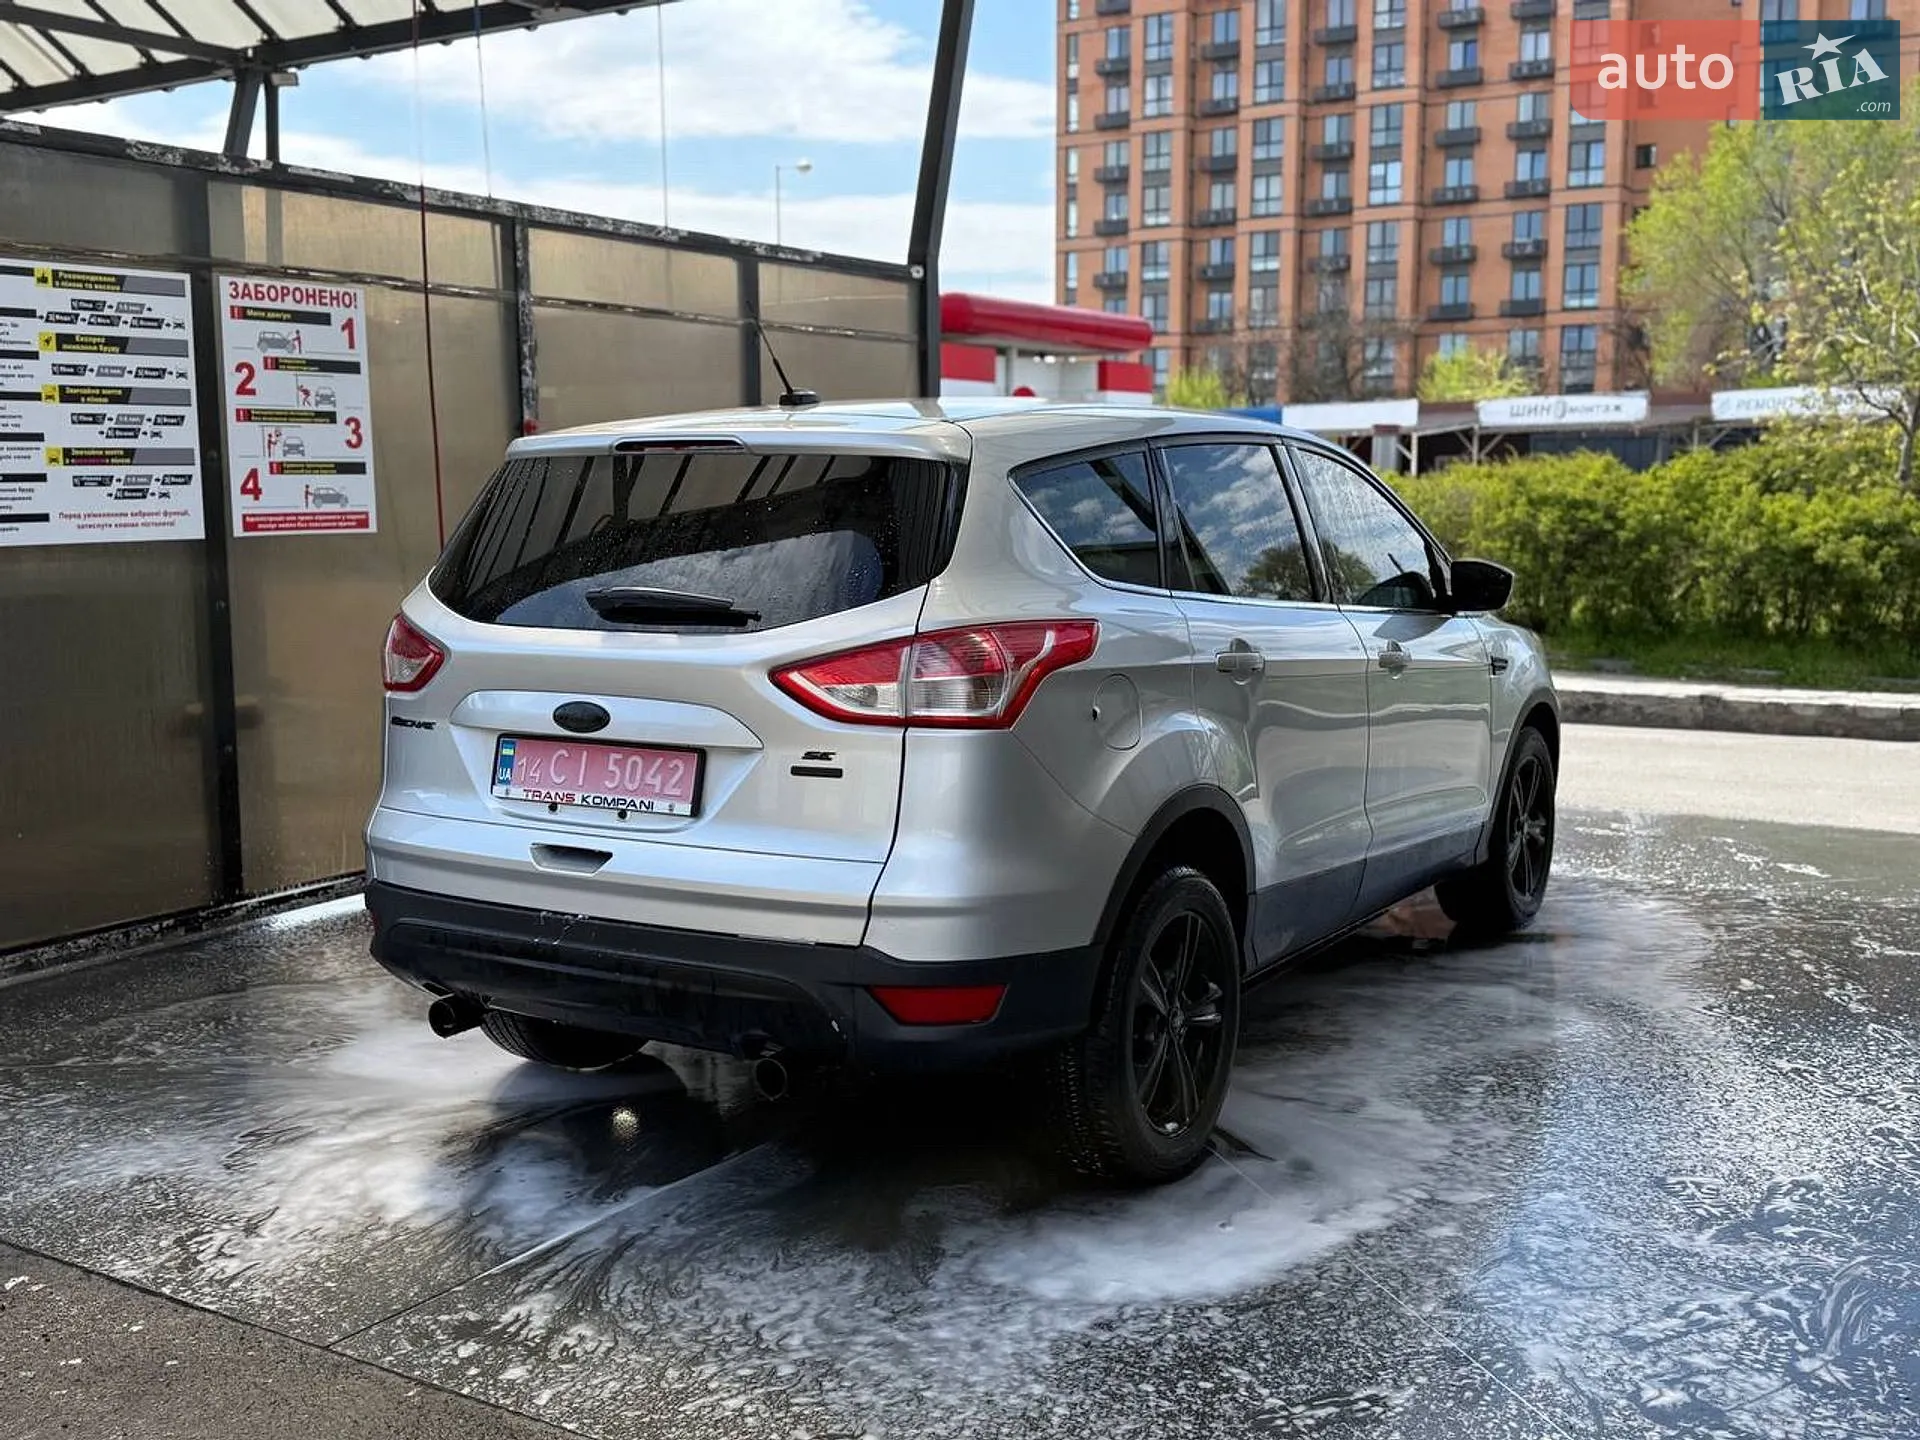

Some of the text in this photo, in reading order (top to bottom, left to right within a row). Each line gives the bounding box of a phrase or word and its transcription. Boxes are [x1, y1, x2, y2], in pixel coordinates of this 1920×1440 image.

[229, 281, 358, 309] ЗАБОРОНЕНО!
[340, 317, 356, 350] 1
[234, 361, 257, 396] 2
[344, 416, 363, 449] 3
[240, 467, 263, 501] 4
[499, 766, 512, 781] UA
[518, 749, 685, 796] 14 CI 5042
[523, 788, 655, 812] TRANS KOMPANI
